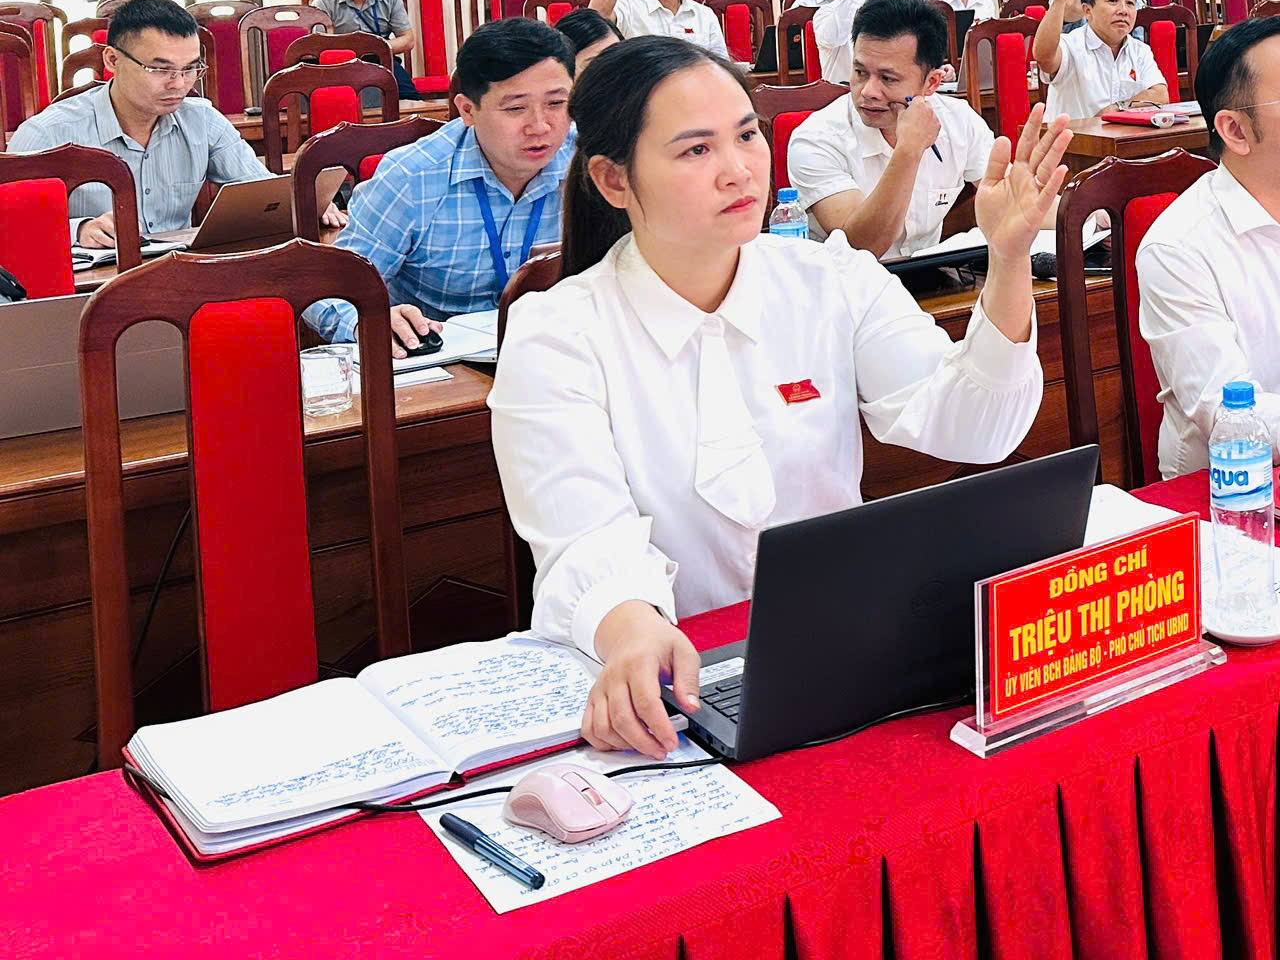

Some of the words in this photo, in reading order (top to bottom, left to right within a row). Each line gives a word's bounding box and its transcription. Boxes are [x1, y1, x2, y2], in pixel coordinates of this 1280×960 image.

[1211, 467, 1249, 489] qua
[1049, 562, 1108, 599] ĐỒNG
[1114, 544, 1148, 577] CHÍ
[1009, 608, 1072, 662] TRIỆU
[1078, 595, 1111, 635] THỊ
[1117, 570, 1185, 623] PHÒNG
[1020, 669, 1041, 692] VIÊN
[1043, 659, 1061, 684] BCH
[1063, 649, 1088, 676] ĐẢNG
[1090, 642, 1102, 668] BỘ
[1109, 632, 1126, 659] PHÓ
[1129, 624, 1145, 652] CHỦ
[1147, 622, 1165, 648] TỊCH
[1166, 612, 1189, 637] UBND
